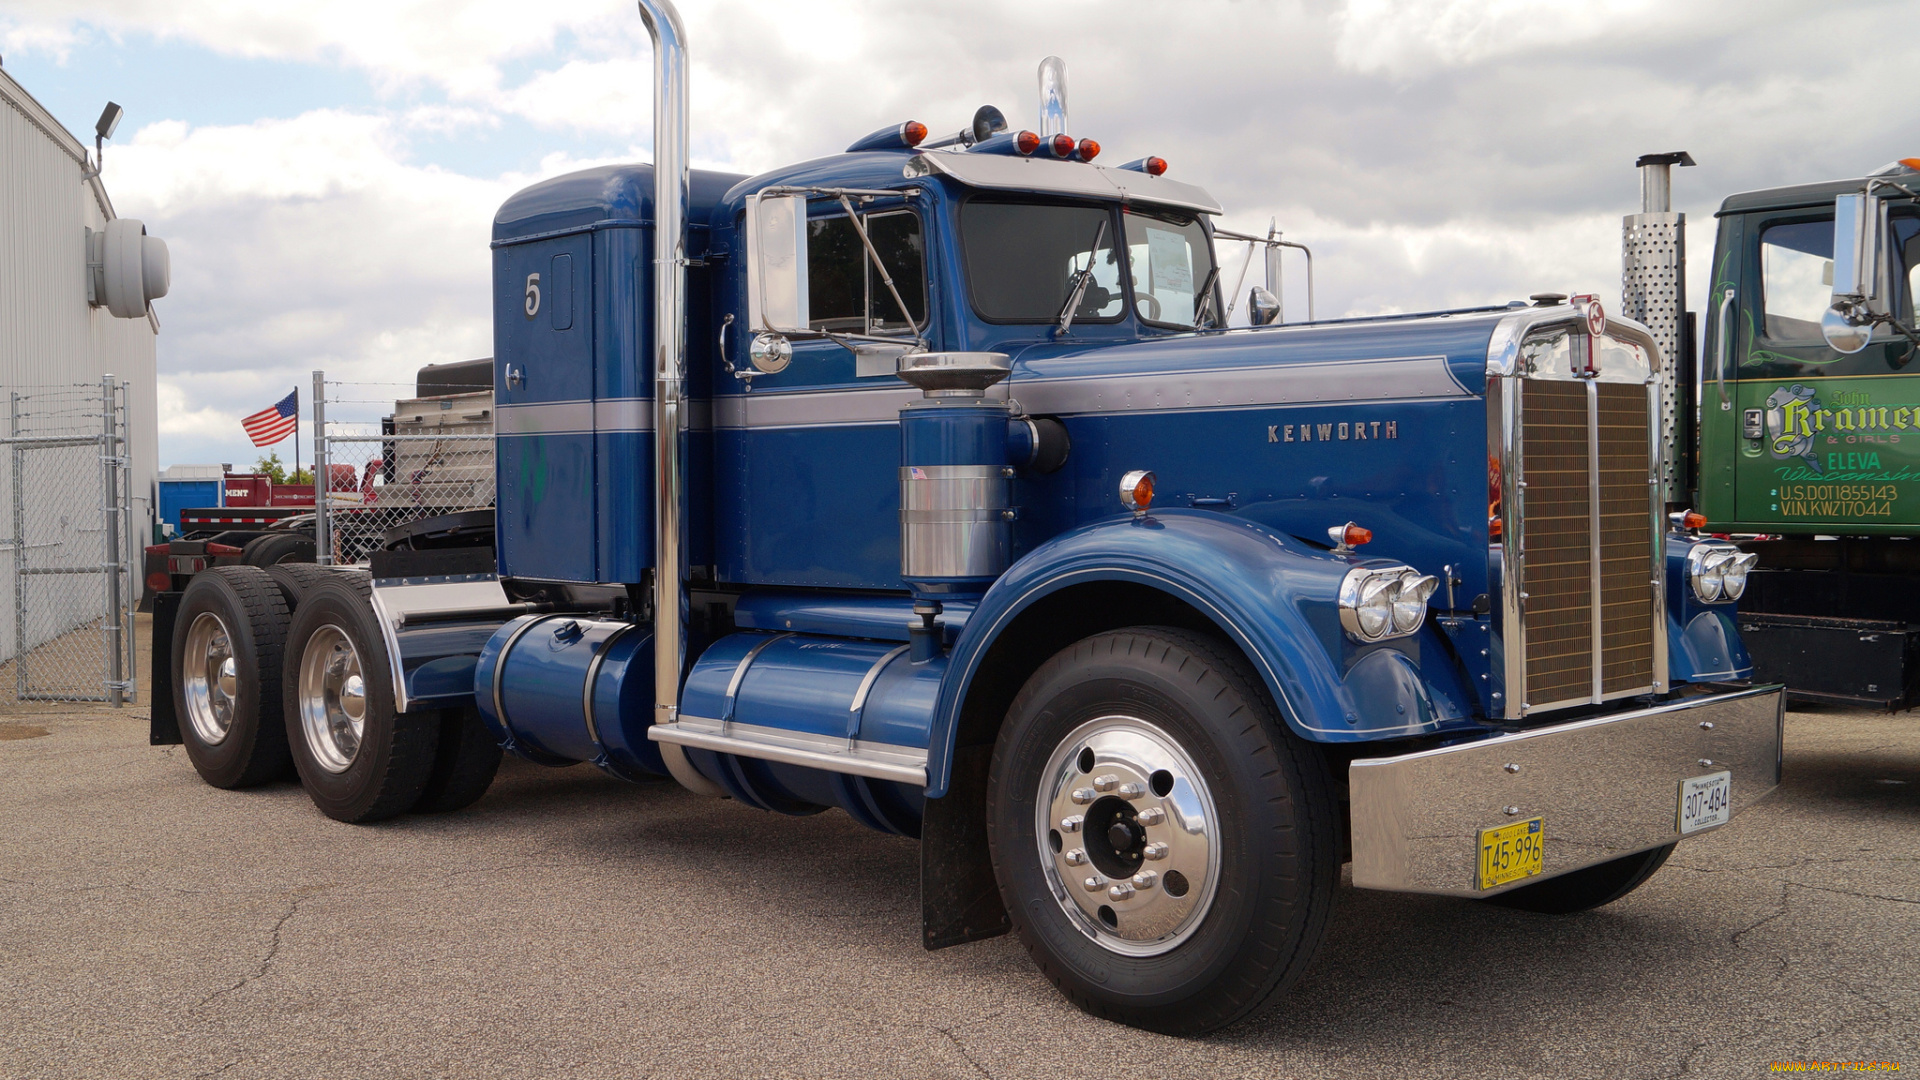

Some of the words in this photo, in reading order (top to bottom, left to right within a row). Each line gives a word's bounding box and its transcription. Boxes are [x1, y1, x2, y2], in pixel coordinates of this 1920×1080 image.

[524, 271, 541, 321] 5
[1830, 389, 1871, 408] John
[1268, 420, 1397, 443] KENWORTH
[1827, 435, 1838, 444] &
[1845, 434, 1901, 444] GIRLS
[1828, 451, 1881, 470] ELEVA
[1774, 464, 1920, 481] Wisconsin
[1685, 785, 1727, 819] 307-484
